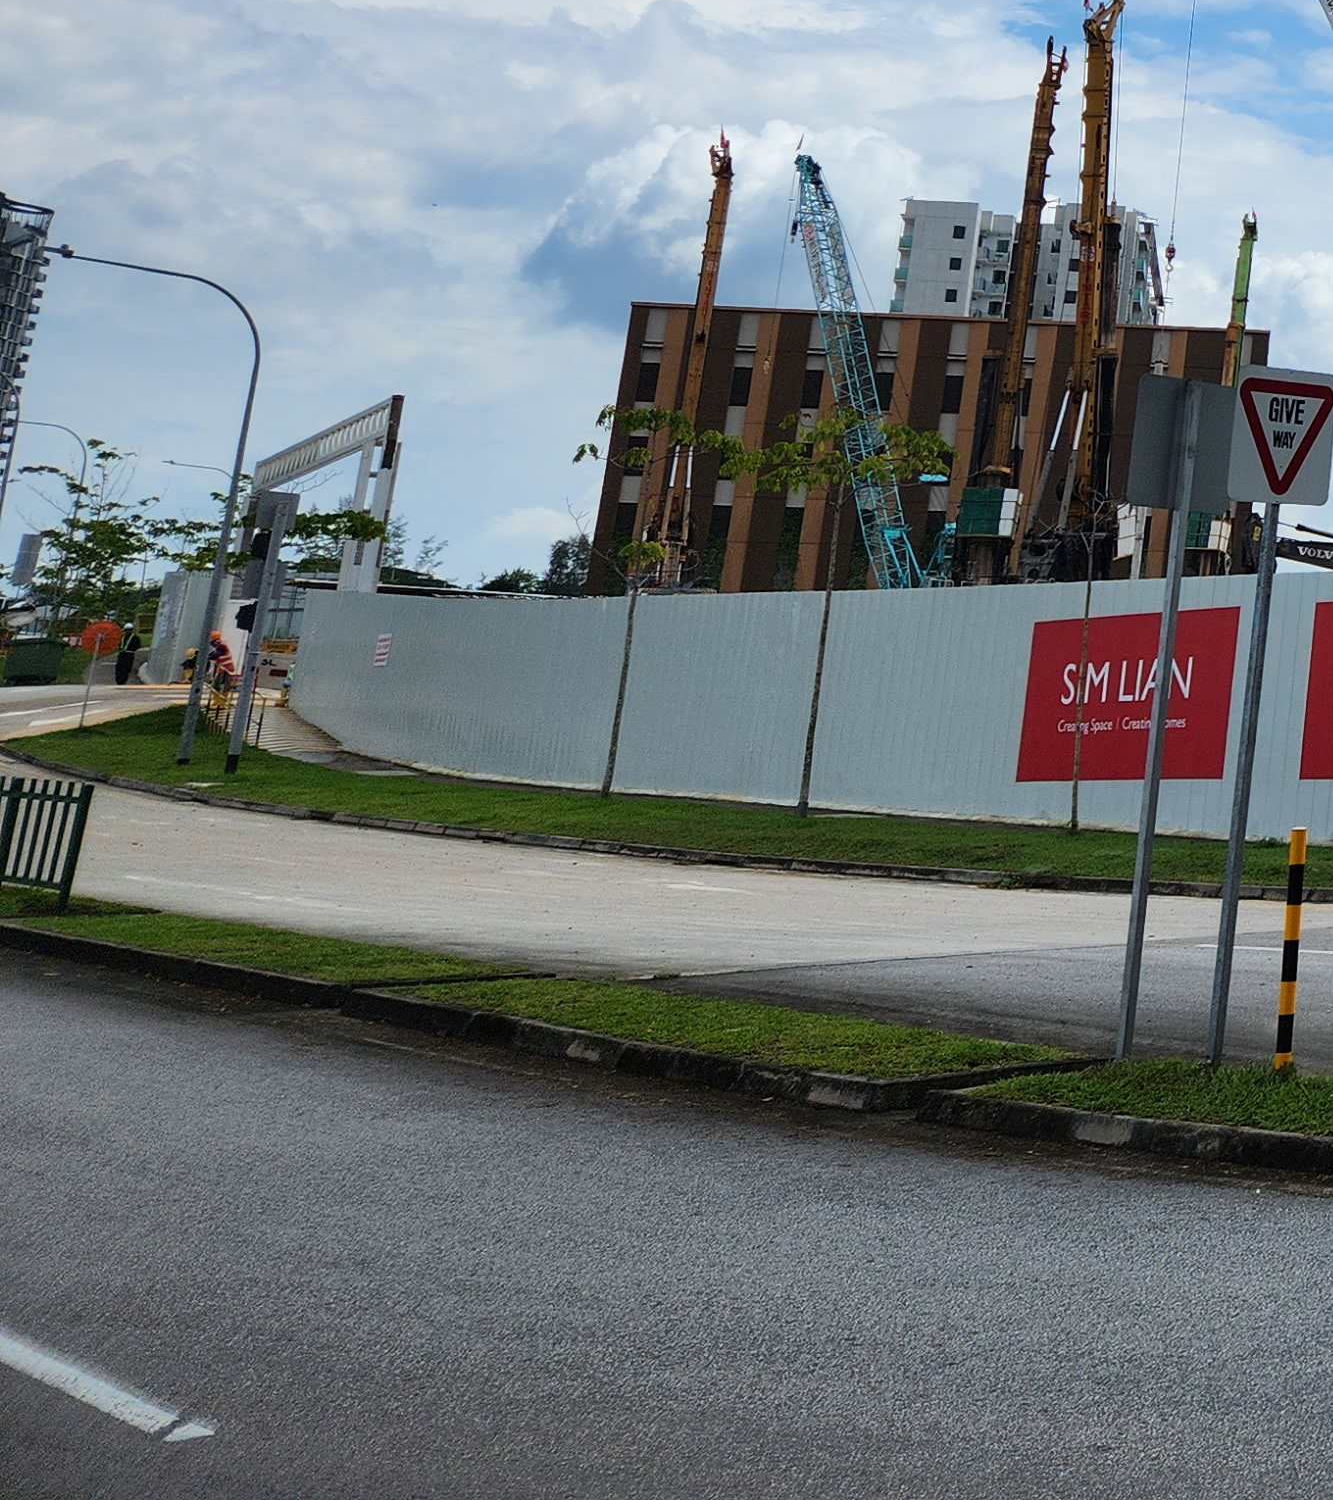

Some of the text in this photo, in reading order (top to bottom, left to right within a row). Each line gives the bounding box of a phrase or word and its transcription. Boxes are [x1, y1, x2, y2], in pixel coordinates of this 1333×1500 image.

[1268, 397, 1305, 425] GIVE
[1273, 431, 1296, 449] WAY
[1118, 656, 1193, 701] LIAN
[1090, 719, 1113, 734] Space
[1122, 717, 1151, 730] Creatin
[1163, 718, 1186, 729] omes
